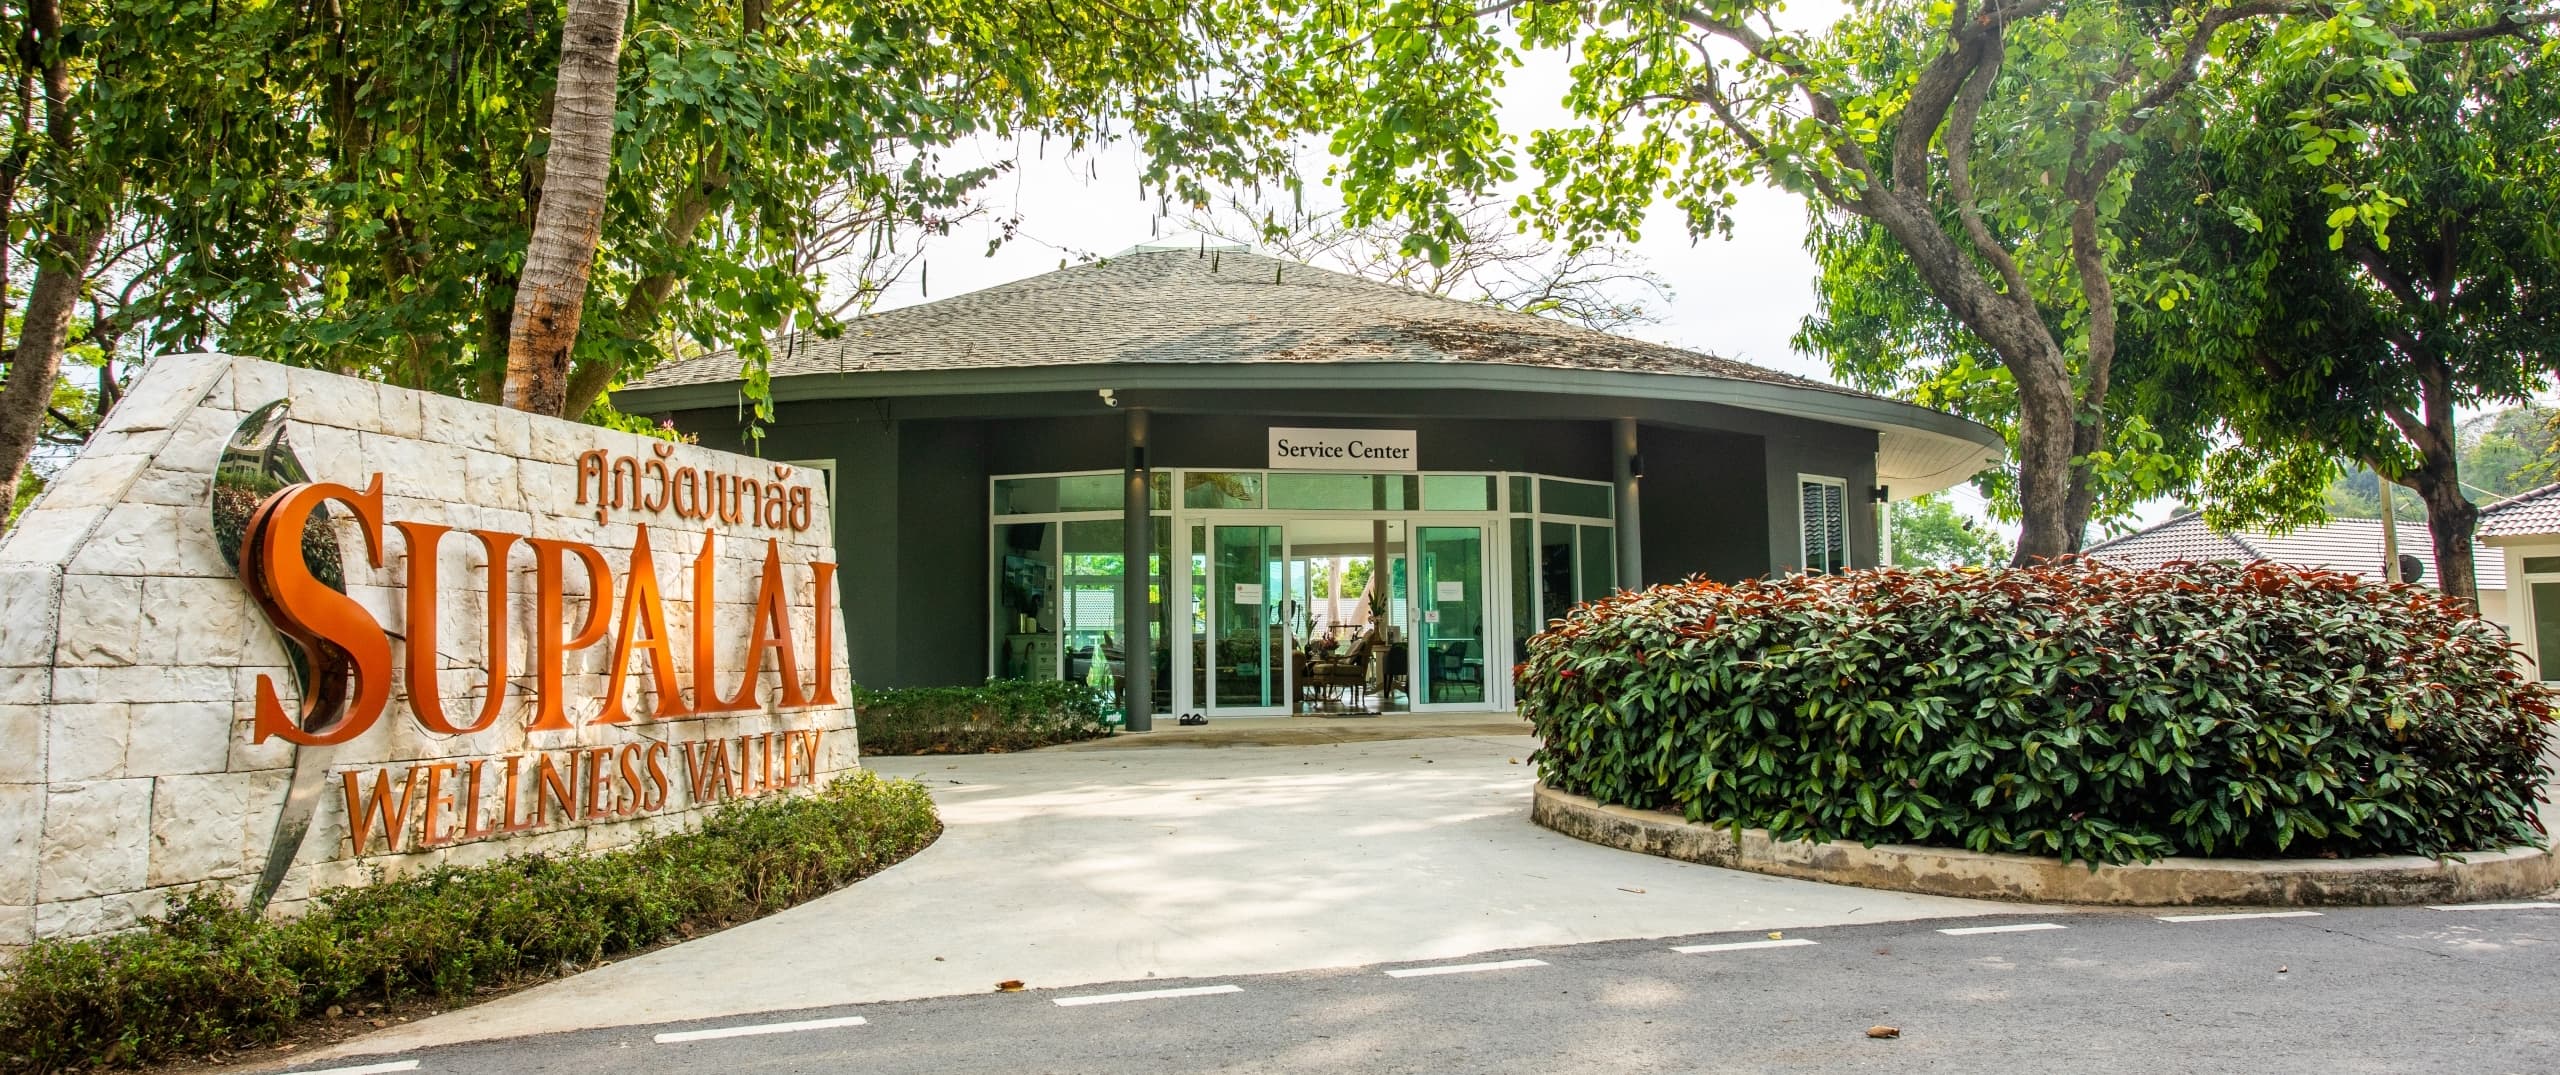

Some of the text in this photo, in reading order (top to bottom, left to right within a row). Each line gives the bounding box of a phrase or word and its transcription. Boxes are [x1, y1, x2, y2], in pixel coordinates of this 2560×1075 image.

[1277, 438, 1410, 459] Service Center
[240, 472, 838, 746] SUPALAI
[341, 728, 824, 856] WELLNESS VALLEY
